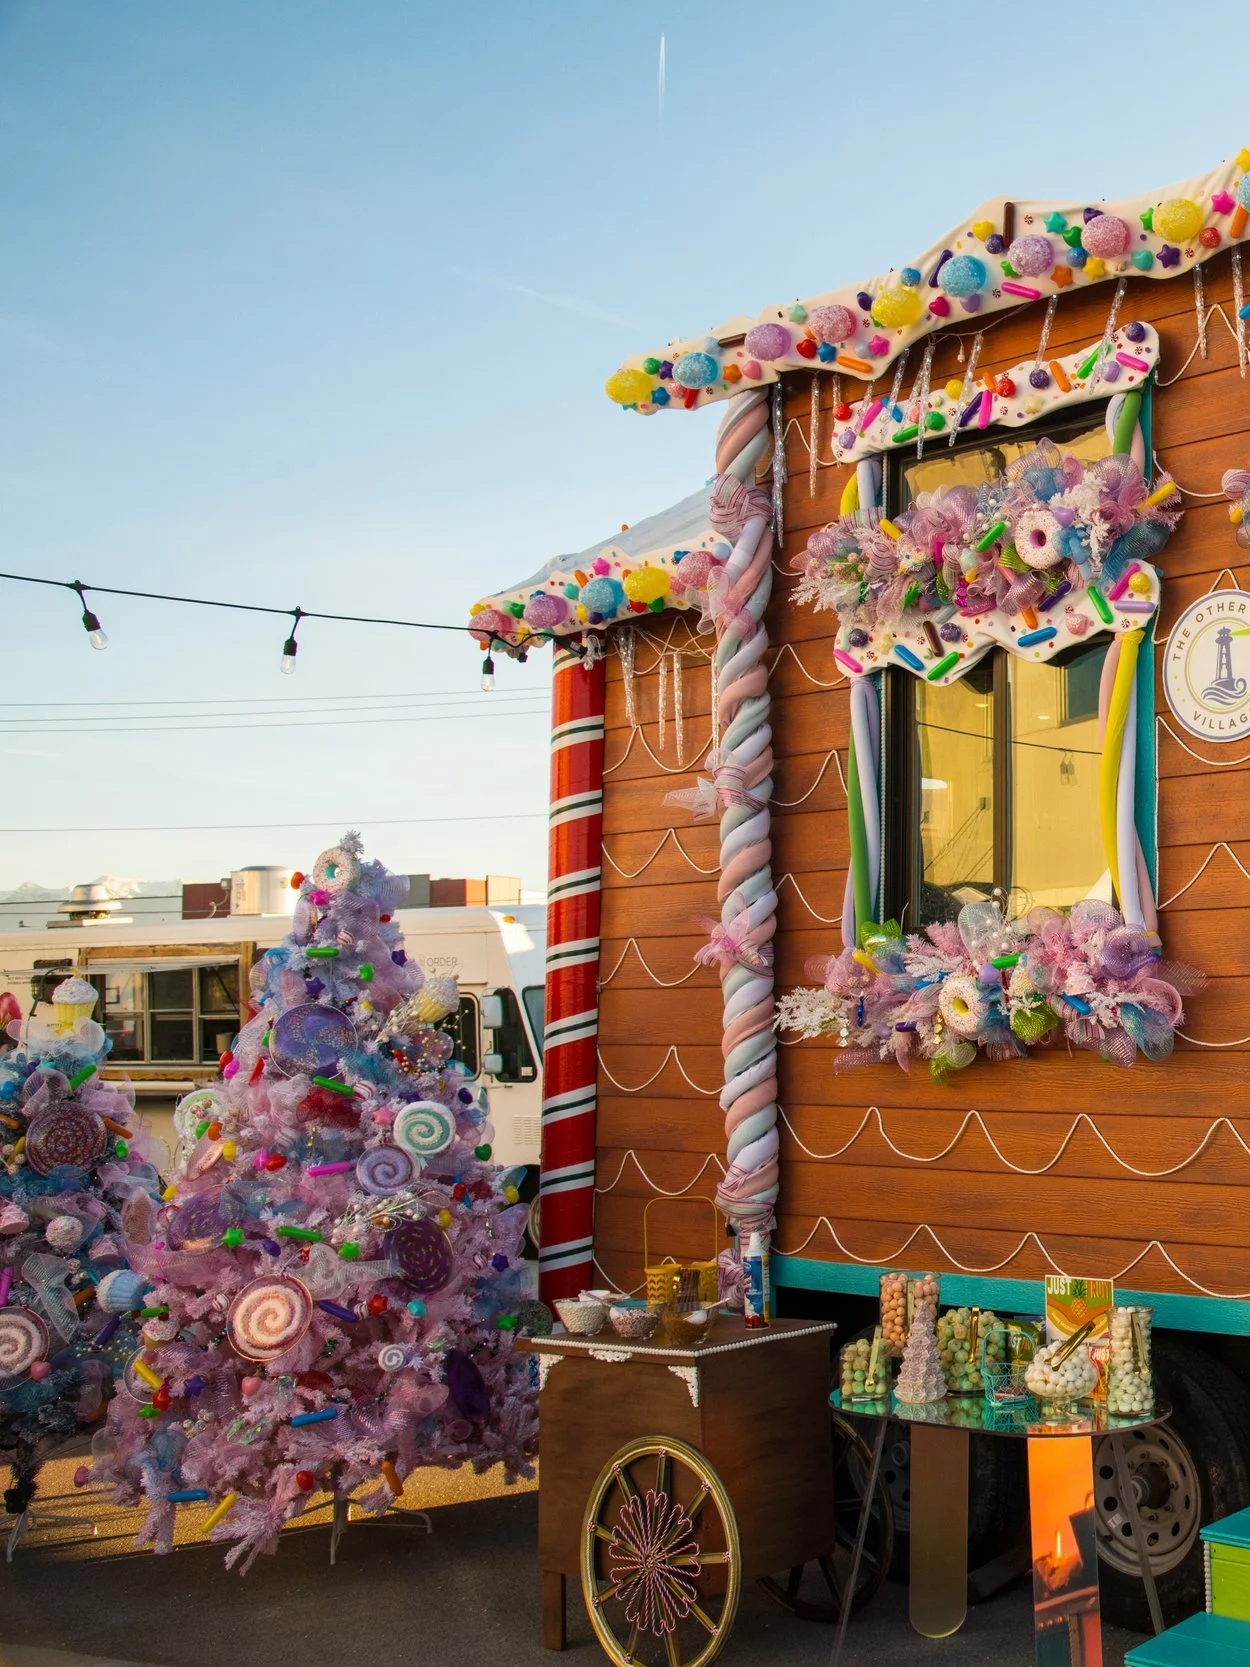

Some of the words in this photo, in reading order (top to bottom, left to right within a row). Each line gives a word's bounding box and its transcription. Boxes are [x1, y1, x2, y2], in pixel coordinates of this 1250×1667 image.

[1172, 627, 1191, 661] THE
[1195, 601, 1247, 623] OTHER
[426, 956, 458, 967] ORDER
[1047, 1277, 1072, 1295] JUST
